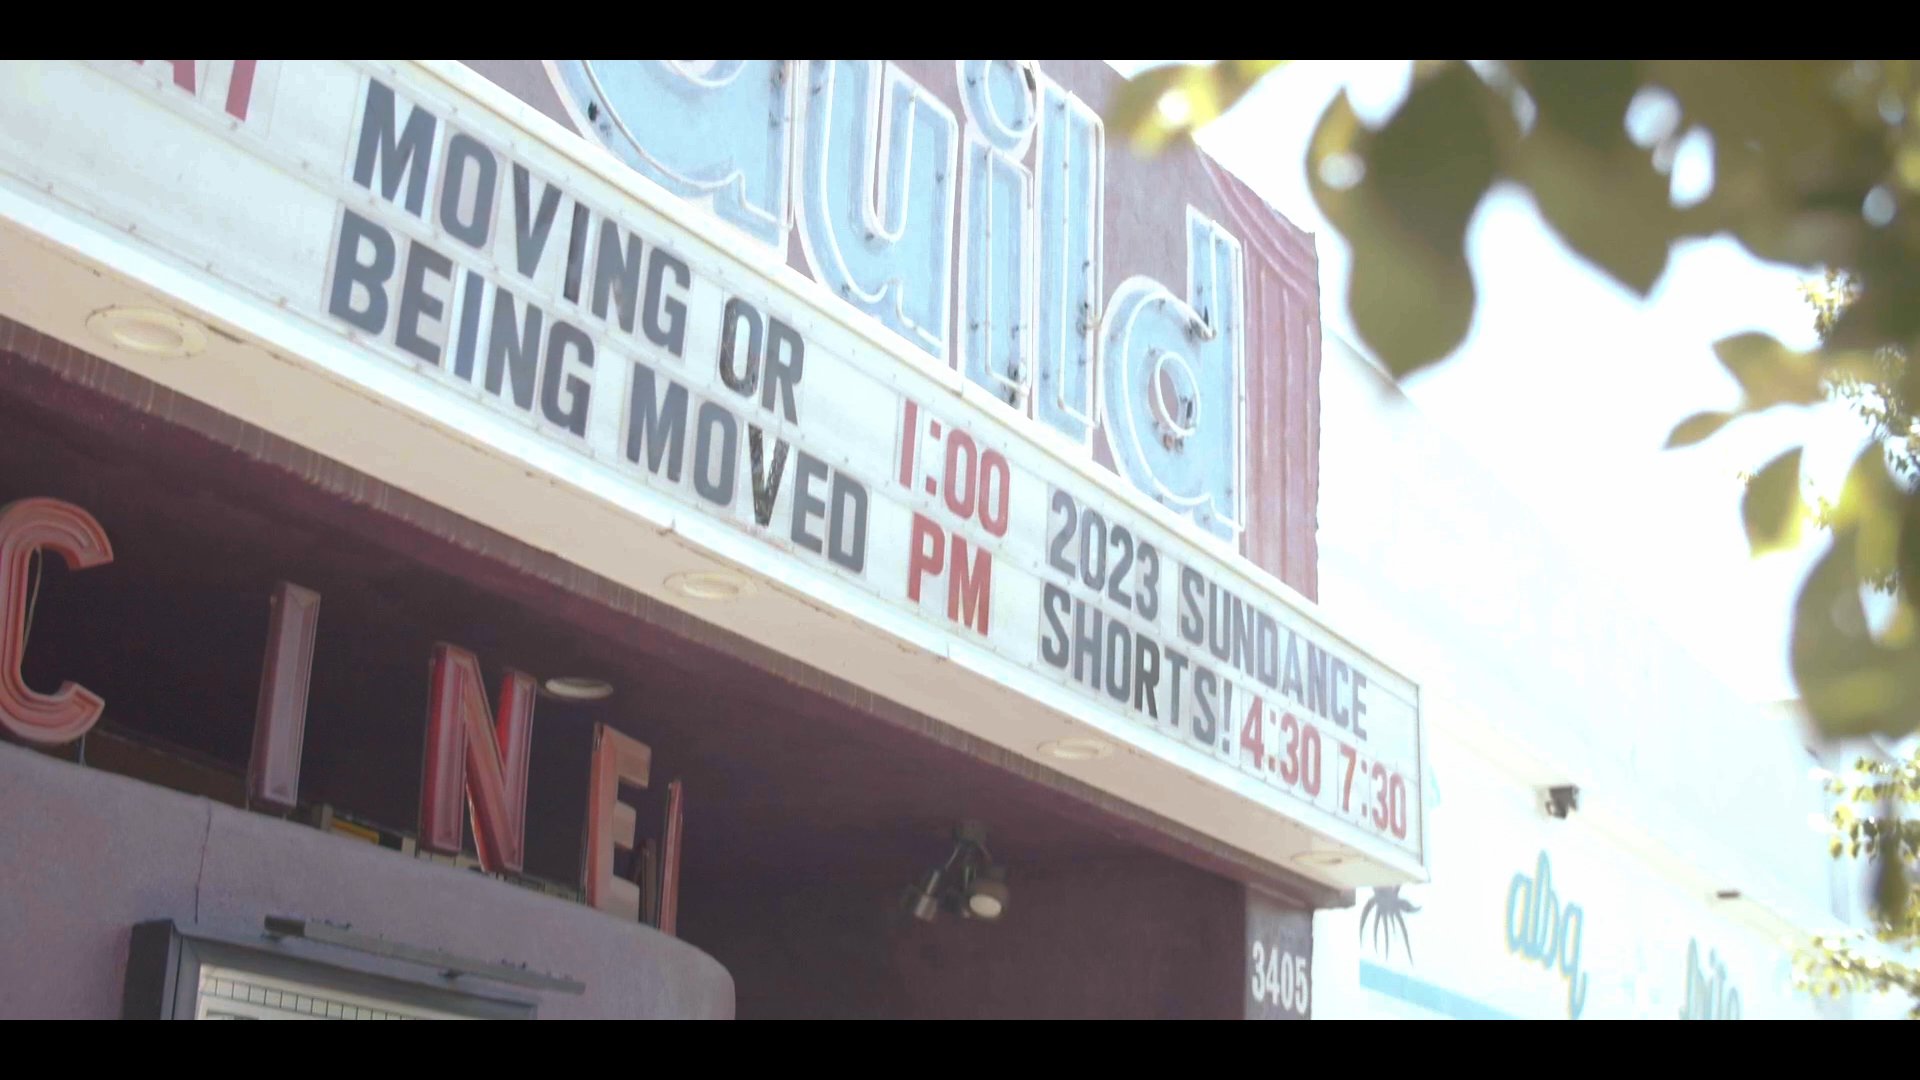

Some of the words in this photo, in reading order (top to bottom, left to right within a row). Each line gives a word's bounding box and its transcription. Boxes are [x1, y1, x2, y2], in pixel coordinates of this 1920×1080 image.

[352, 77, 691, 359] MOVING
[719, 296, 805, 426] OR
[328, 209, 595, 439] BEING
[626, 361, 869, 575] MOVED
[899, 399, 1011, 538] 1:00
[908, 512, 993, 637] PM
[1049, 489, 1160, 623] 2023
[1179, 562, 1368, 742] SUNDANCE
[0, 497, 683, 938] CINE
[1041, 581, 1234, 755] SHORTS!
[1239, 695, 1322, 798] 4:30
[1339, 746, 1408, 841] 7:30
[1251, 940, 1309, 1015] 3405
